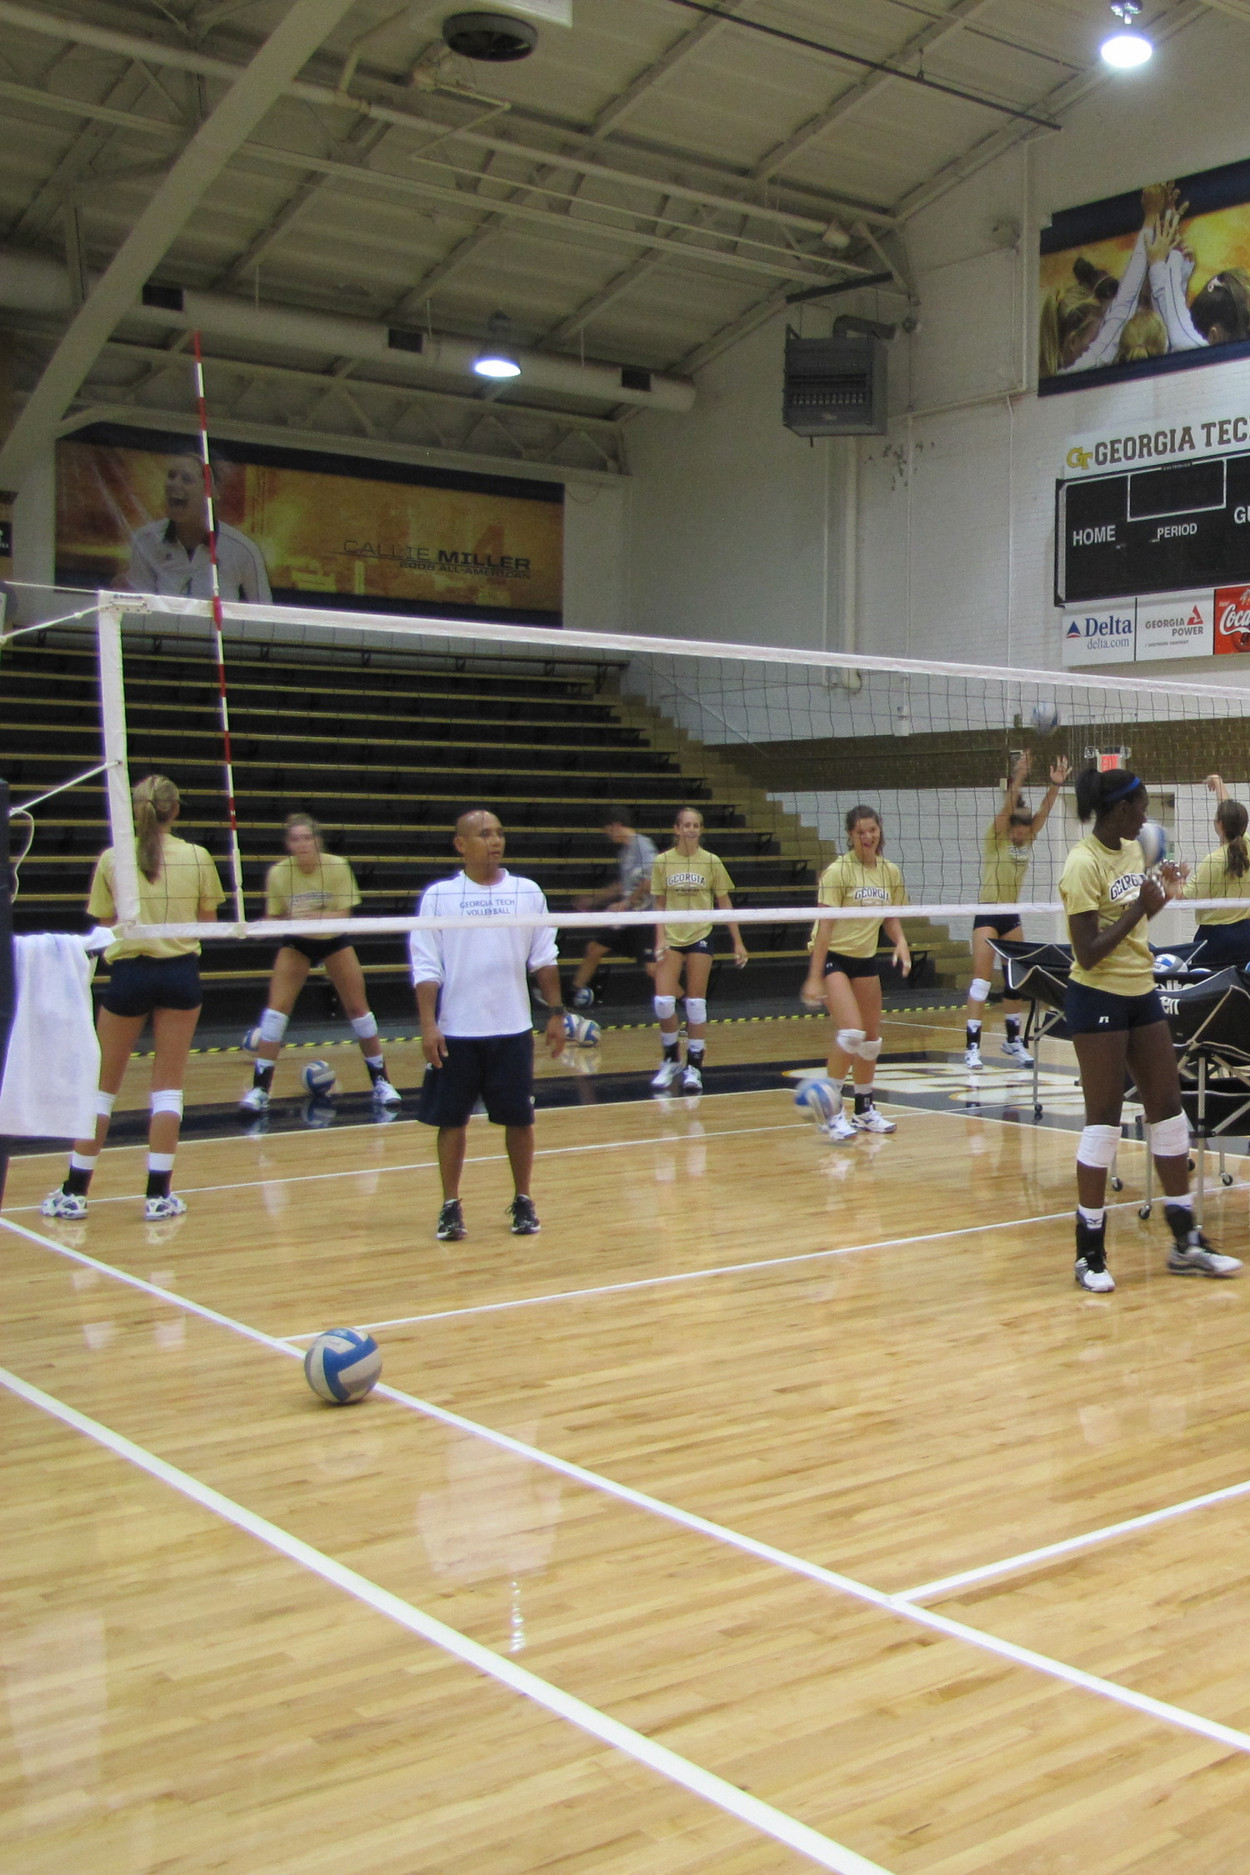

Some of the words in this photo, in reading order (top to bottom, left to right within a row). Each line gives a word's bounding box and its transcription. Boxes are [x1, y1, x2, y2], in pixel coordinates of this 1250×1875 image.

[1066, 447, 1093, 471] GT
[1094, 426, 1196, 466] GEORGIA
[1072, 525, 1116, 547] HOME
[1156, 523, 1198, 539] PERIOD
[343, 540, 430, 562] CALLIE
[437, 550, 532, 571] MILLER
[1084, 615, 1133, 637] Delta
[1145, 617, 1186, 630] GEORGIA
[1171, 626, 1204, 637] POWER
[1086, 638, 1130, 650] delta.com
[667, 872, 707, 887] GEORGIA
[460, 899, 494, 909] GEORGIA
[495, 898, 516, 907] TECH
[467, 907, 511, 917] VOLLEYBALL
